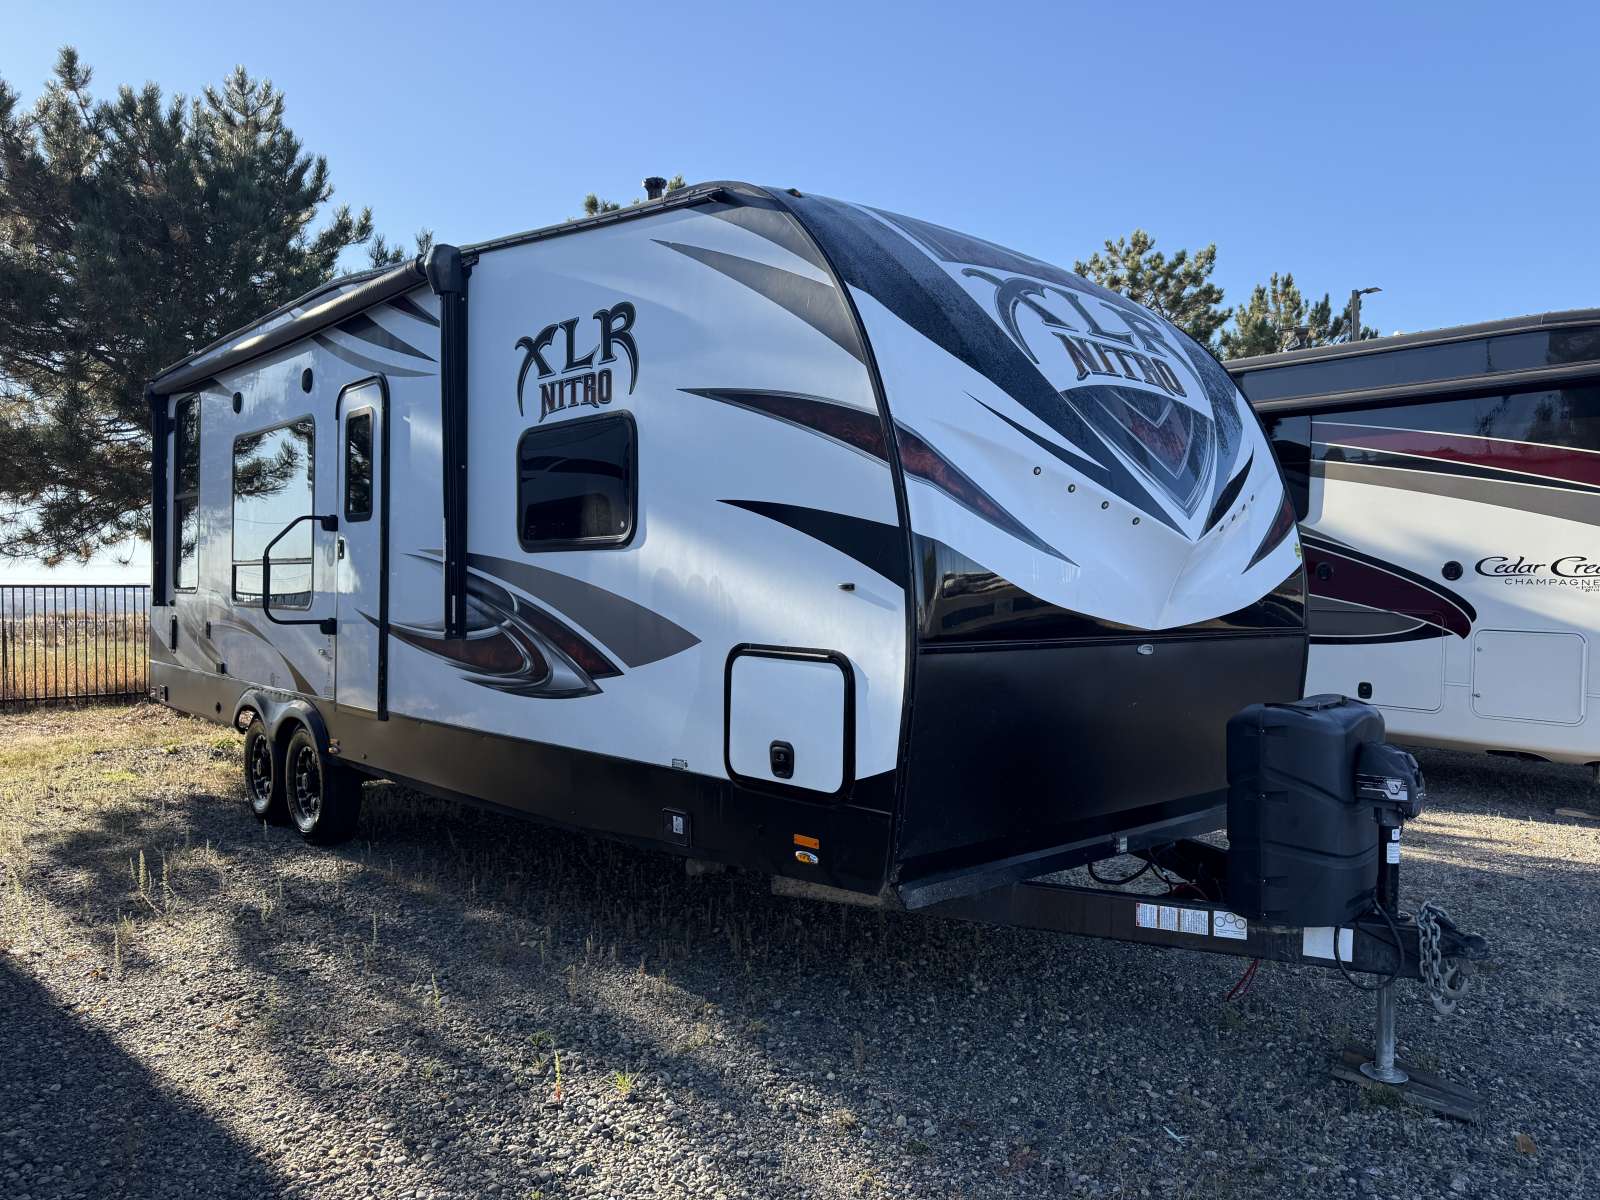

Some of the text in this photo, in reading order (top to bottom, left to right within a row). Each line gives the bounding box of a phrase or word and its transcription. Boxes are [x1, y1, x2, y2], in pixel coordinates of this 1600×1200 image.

[514, 300, 640, 417] XLR
[961, 267, 1209, 401] XLR
[1051, 331, 1188, 398] NITRO
[538, 367, 612, 423] NITRO
[1475, 555, 1547, 577] Cedar
